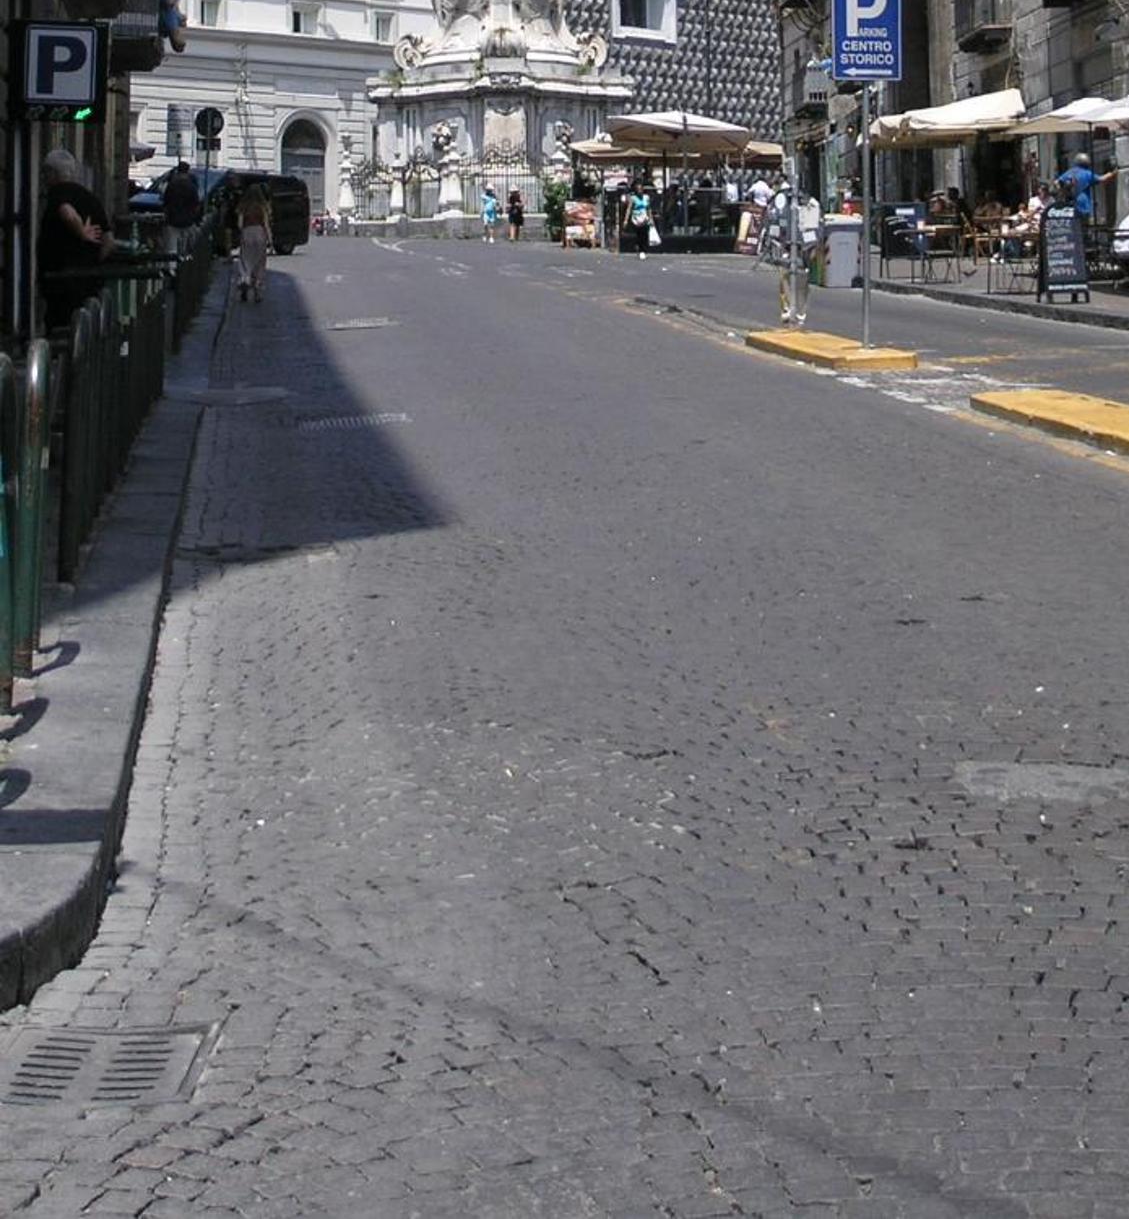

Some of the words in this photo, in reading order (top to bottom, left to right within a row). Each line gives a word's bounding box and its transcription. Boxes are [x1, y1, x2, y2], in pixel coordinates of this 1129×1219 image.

[842, 40, 893, 52] CENTRO
[37, 35, 88, 95] P
[840, 53, 895, 65] STORICO
